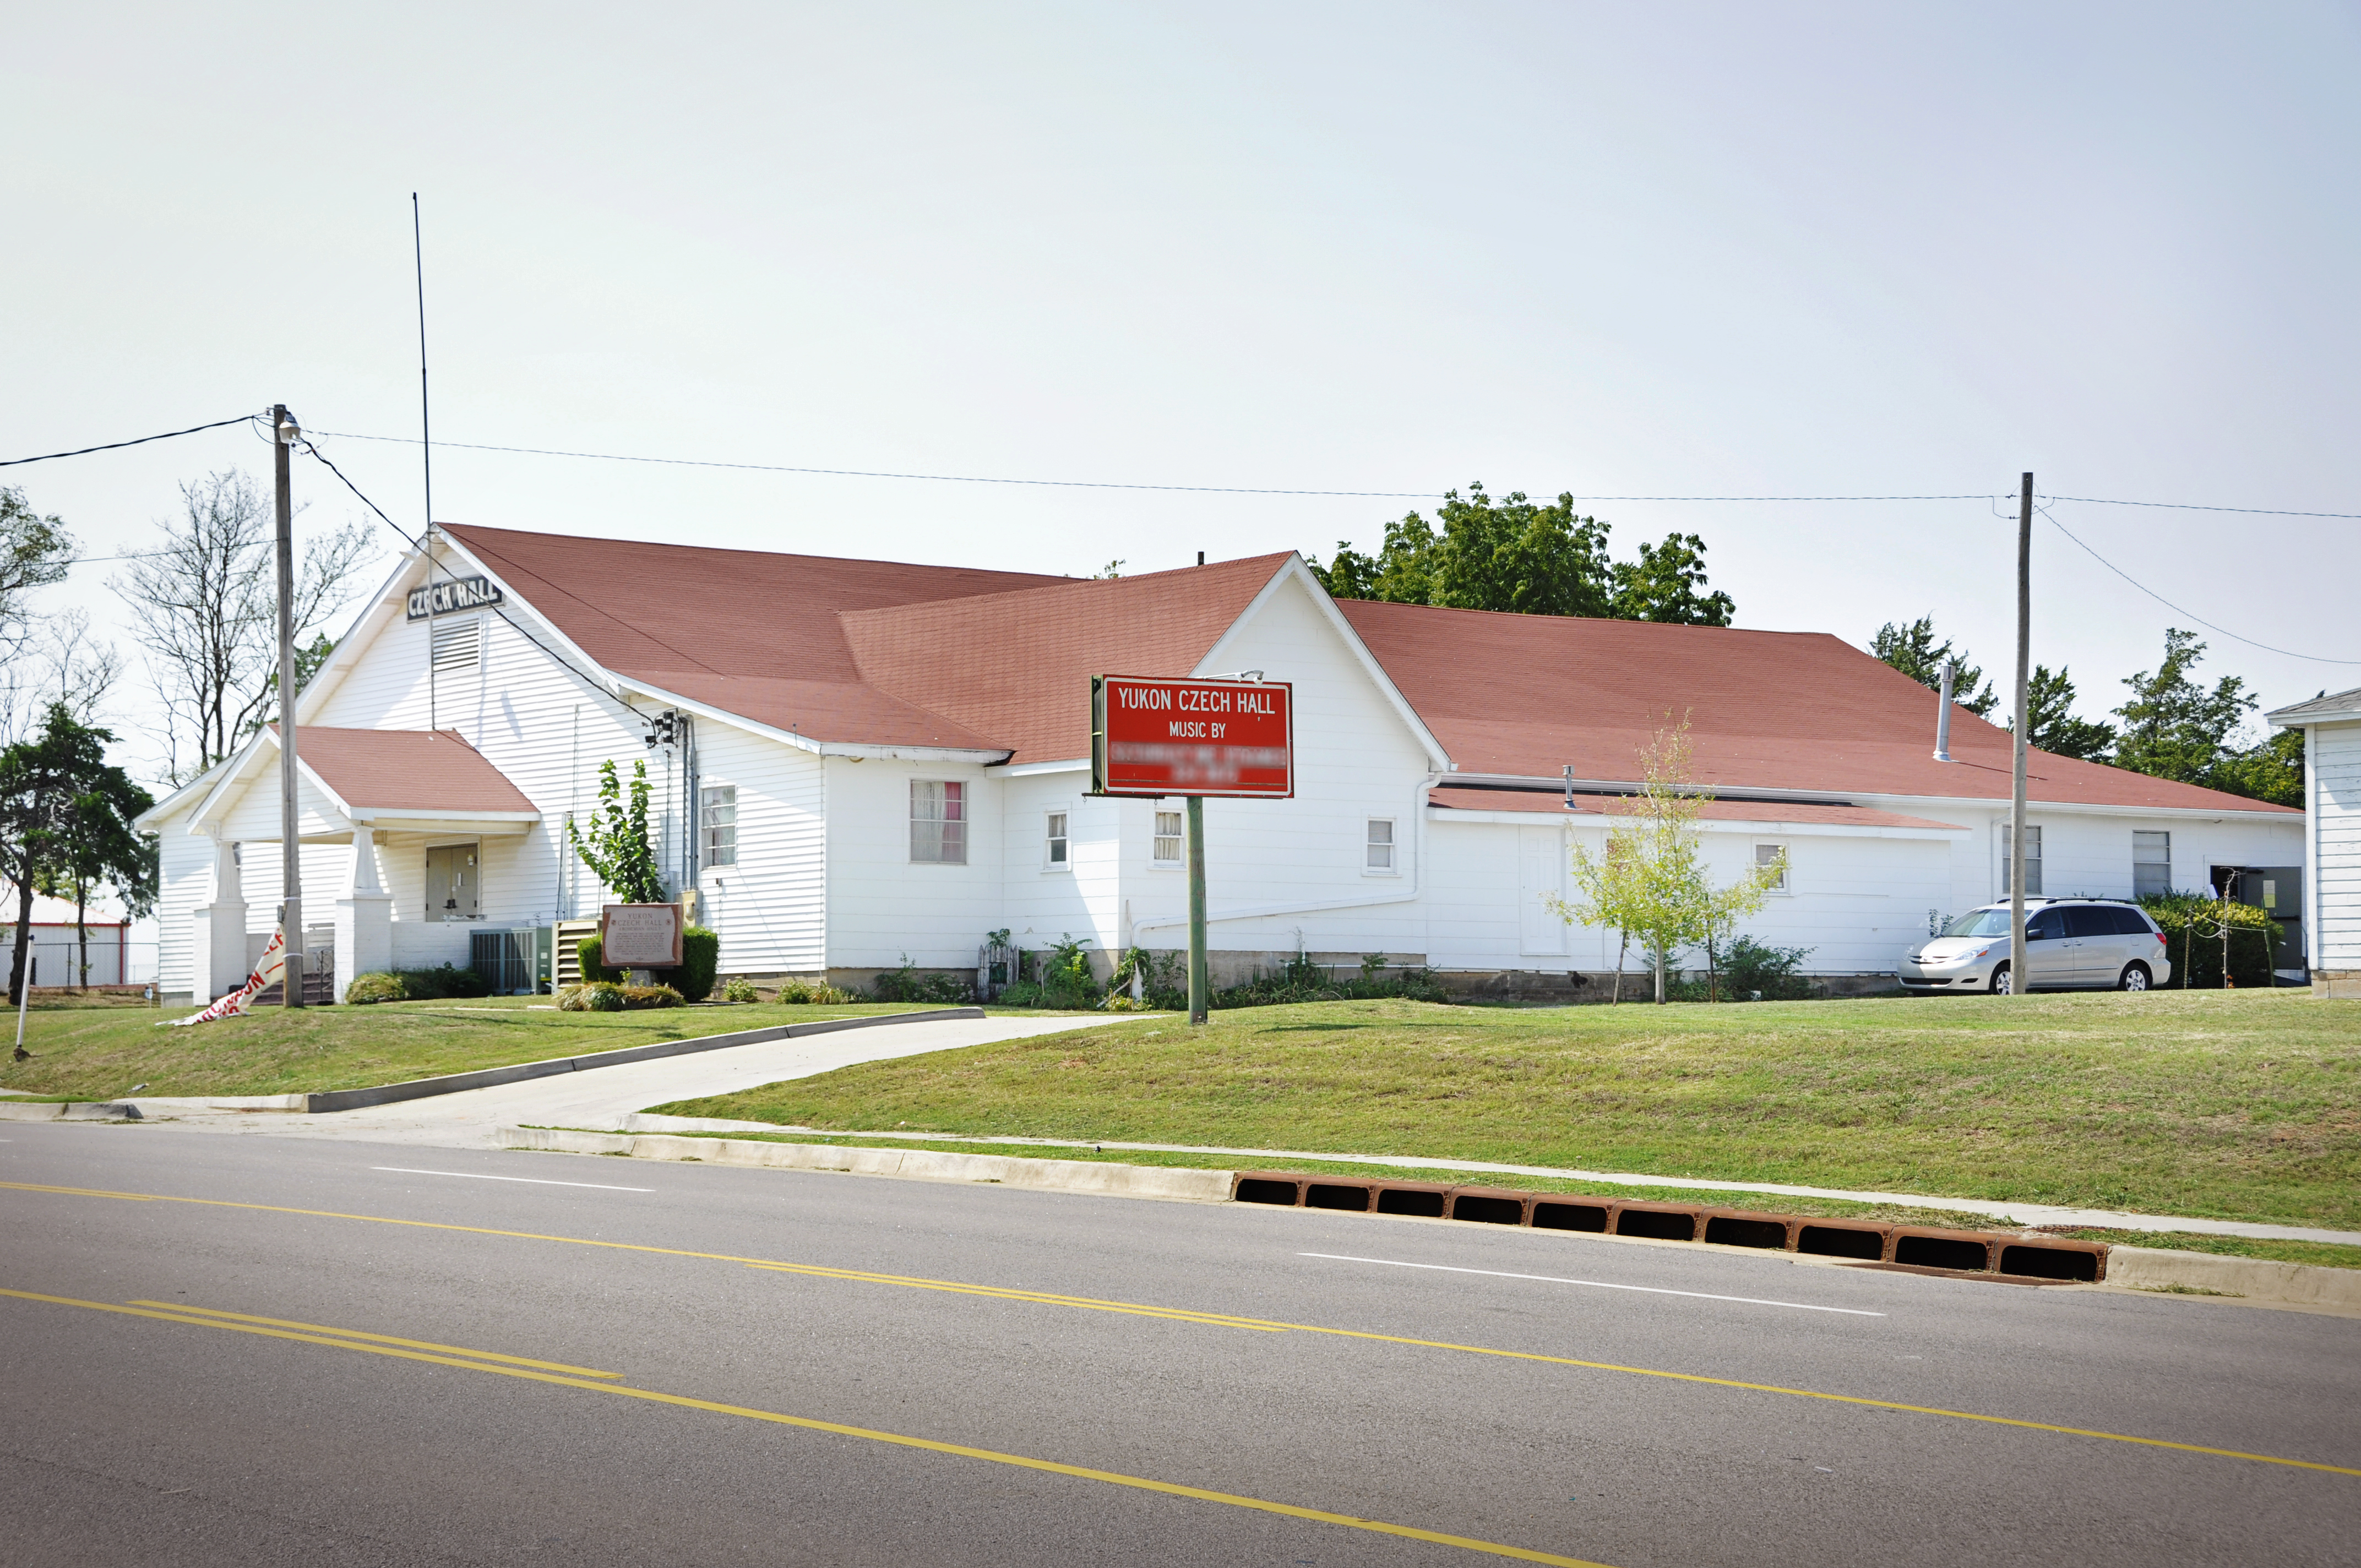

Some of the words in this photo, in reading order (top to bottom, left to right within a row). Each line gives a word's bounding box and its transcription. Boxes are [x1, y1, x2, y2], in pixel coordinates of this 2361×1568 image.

[409, 586, 453, 616] CZECH
[456, 579, 498, 607] HALL
[1118, 688, 1171, 710] YUKON
[1179, 690, 1230, 712] CZECH
[1237, 693, 1275, 714] HALL
[1169, 721, 1206, 738] MUSIC
[1211, 722, 1226, 738] BY
